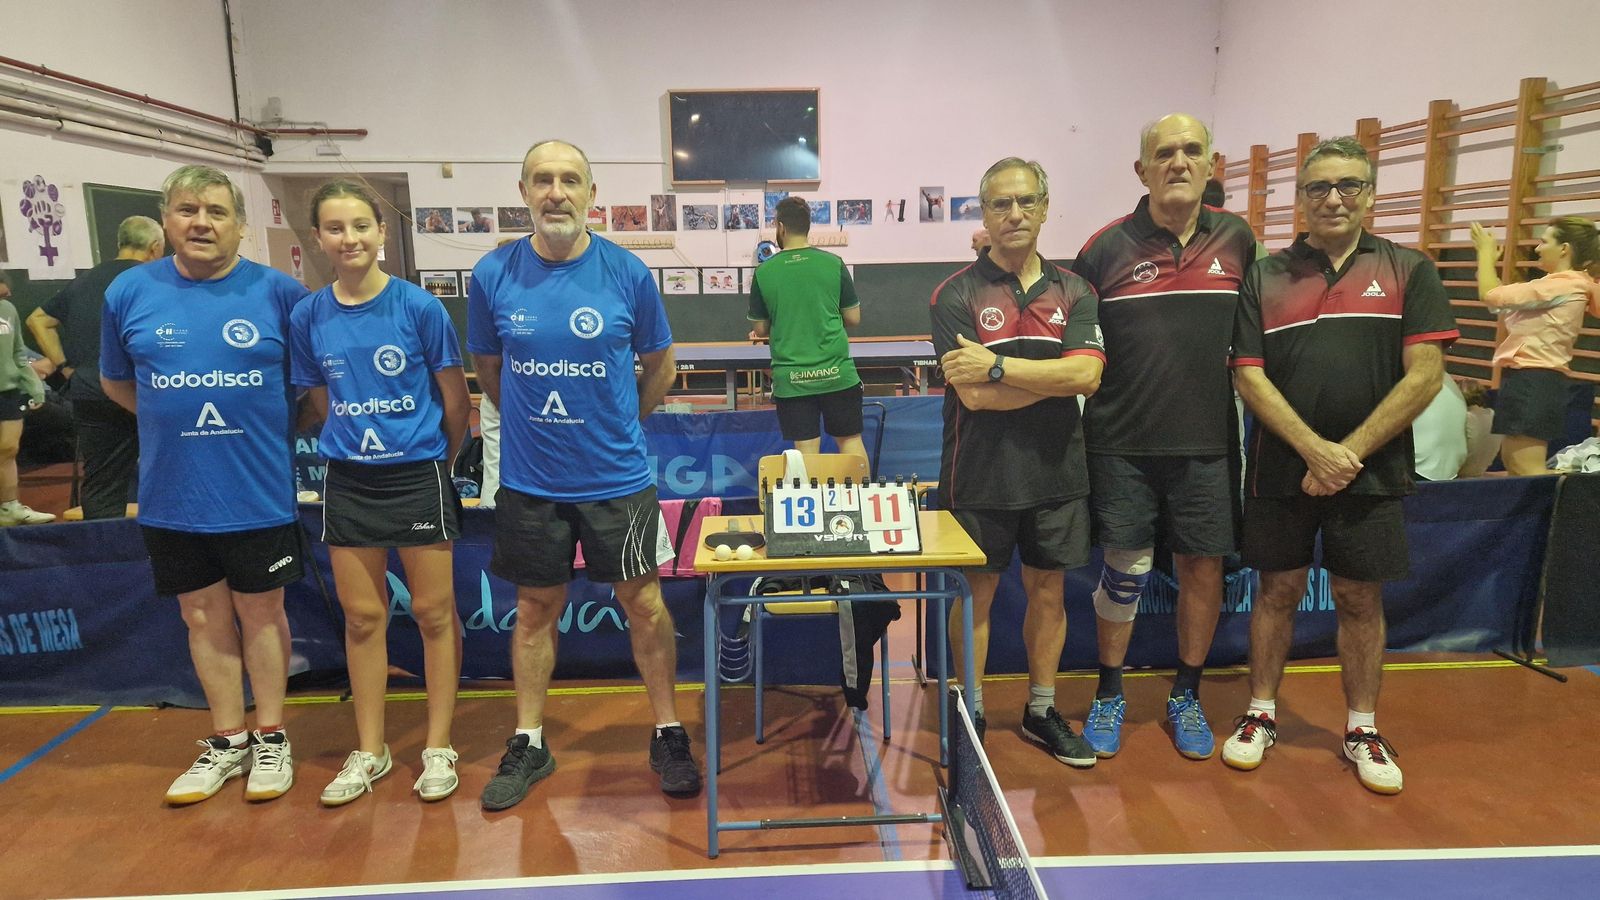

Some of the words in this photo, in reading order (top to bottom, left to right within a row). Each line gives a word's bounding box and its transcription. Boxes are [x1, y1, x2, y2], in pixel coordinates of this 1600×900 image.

[828, 490, 836, 506] 2
[846, 490, 852, 505] 1
[868, 493, 901, 522] 11
[780, 496, 816, 527] 13
[268, 555, 293, 573] GEWO
[8, 612, 38, 654] DE
[32, 608, 84, 652] MESA
